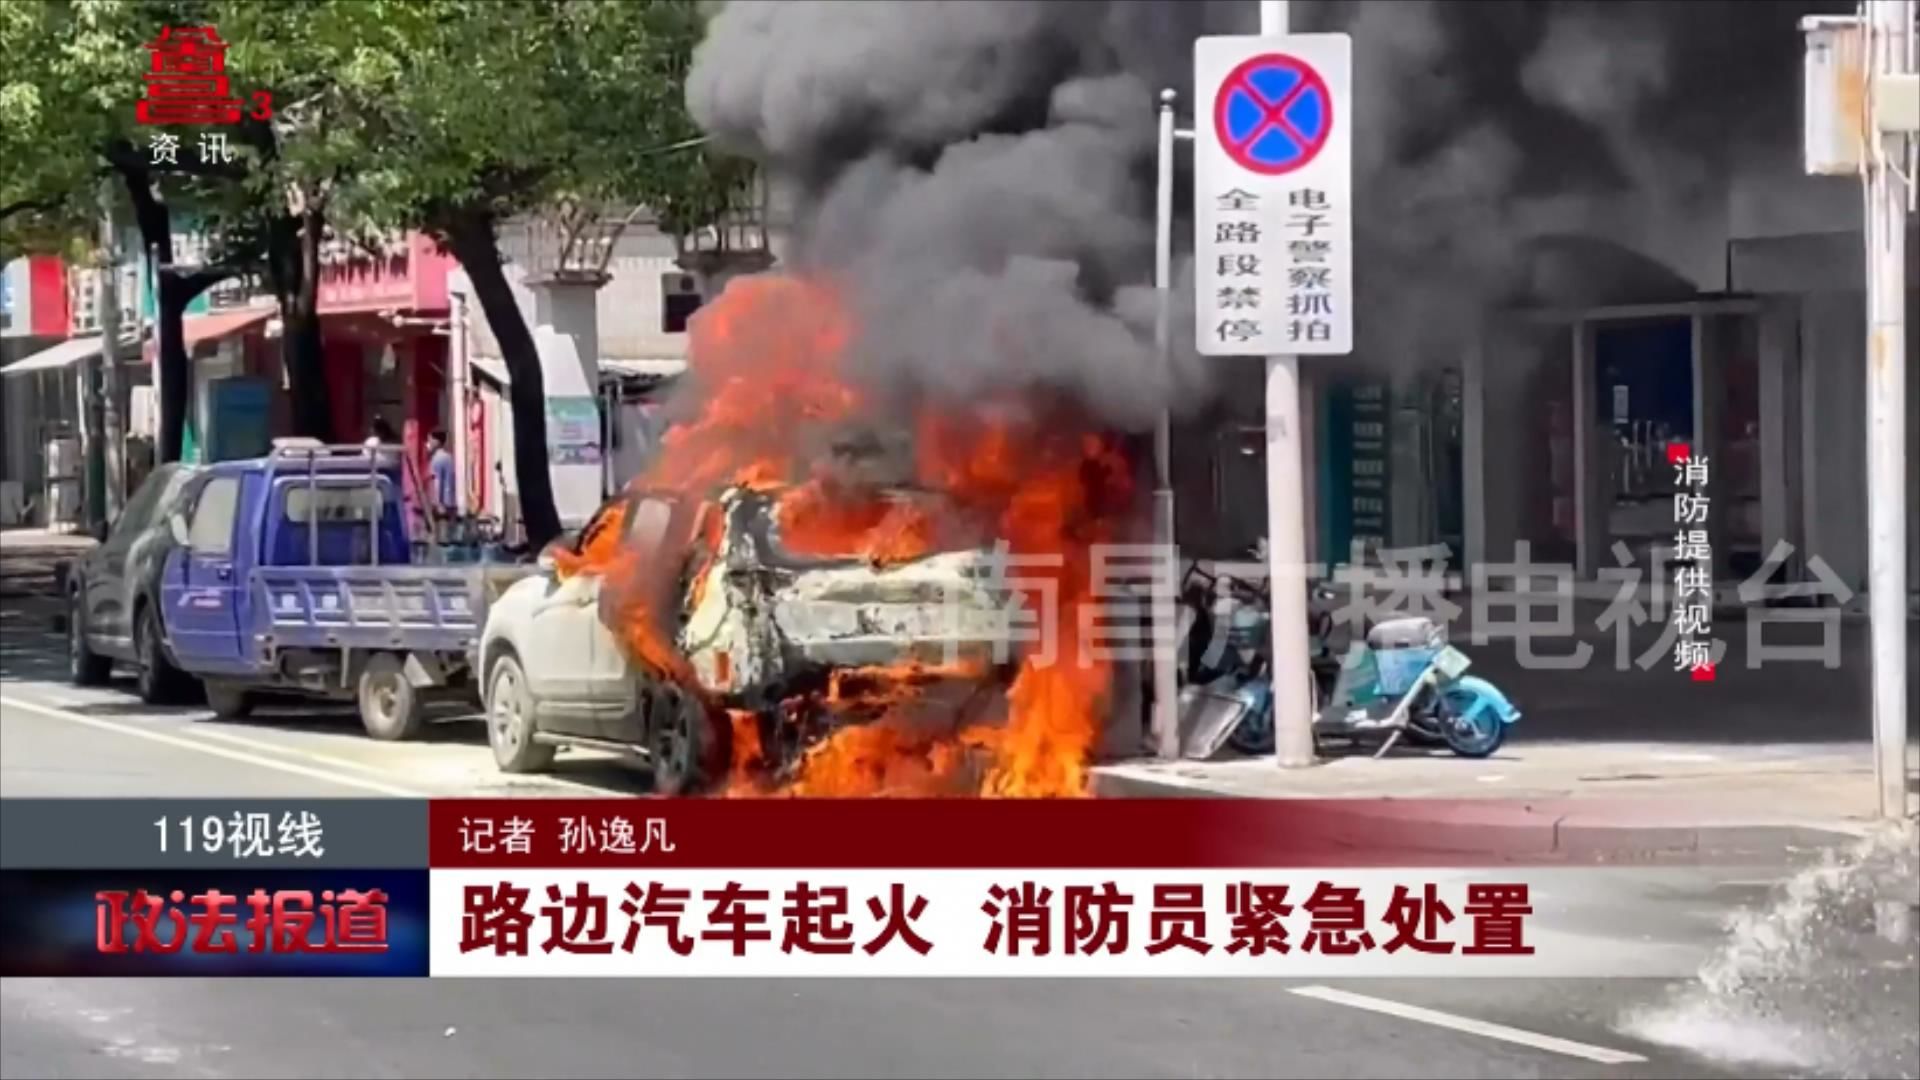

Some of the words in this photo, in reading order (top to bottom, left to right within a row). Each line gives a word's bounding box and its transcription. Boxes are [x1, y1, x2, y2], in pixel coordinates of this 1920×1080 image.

[1215, 188, 1261, 342] 全路段禁停
[1286, 188, 1333, 342] 电子警察抓拍
